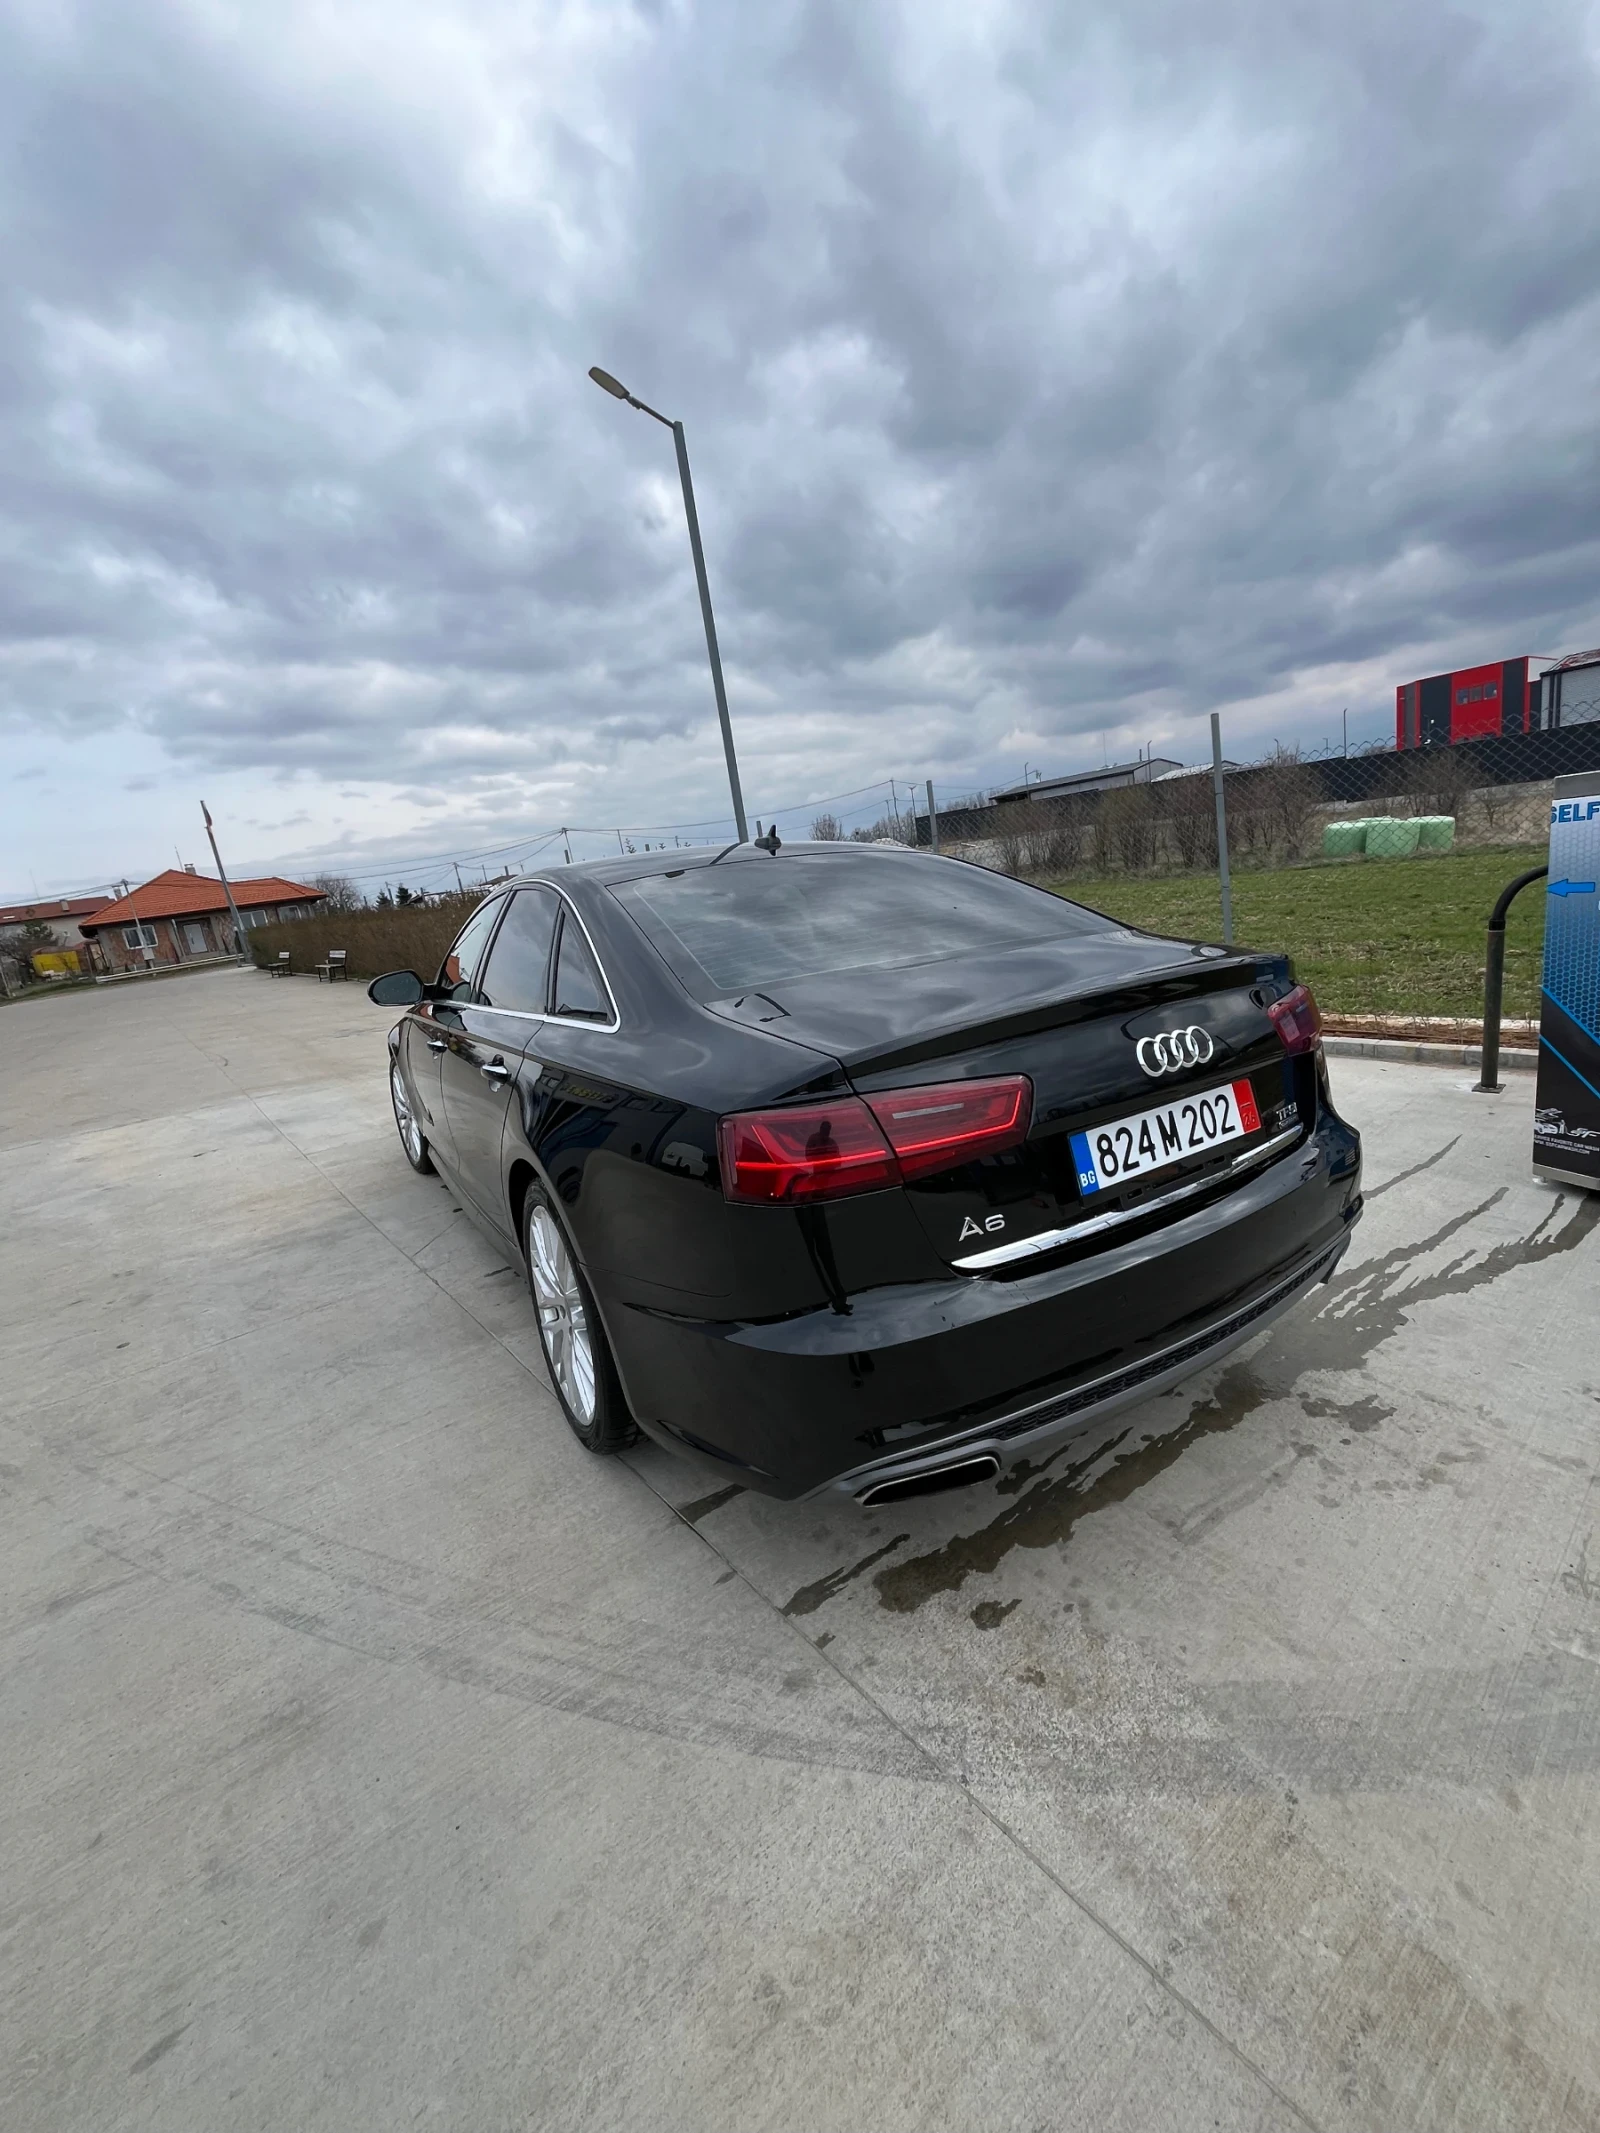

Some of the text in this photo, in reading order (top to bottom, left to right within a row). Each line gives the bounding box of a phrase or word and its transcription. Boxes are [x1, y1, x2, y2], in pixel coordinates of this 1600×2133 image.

[1096, 1094, 1236, 1178] 824M202
[1079, 1171, 1097, 1188] BG
[958, 1213, 1006, 1242] A6
